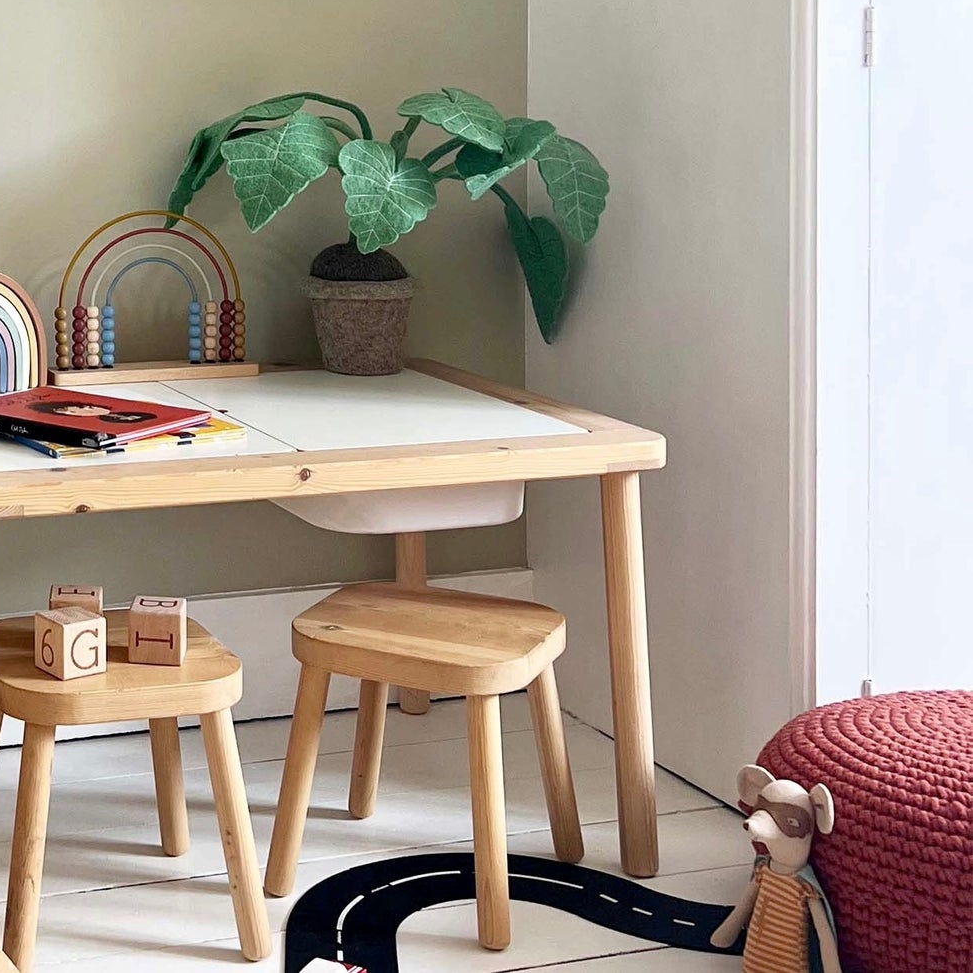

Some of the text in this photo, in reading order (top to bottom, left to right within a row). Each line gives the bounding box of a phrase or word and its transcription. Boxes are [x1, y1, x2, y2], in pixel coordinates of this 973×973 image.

[139, 598, 178, 608] B
[41, 628, 99, 669] 6 G
